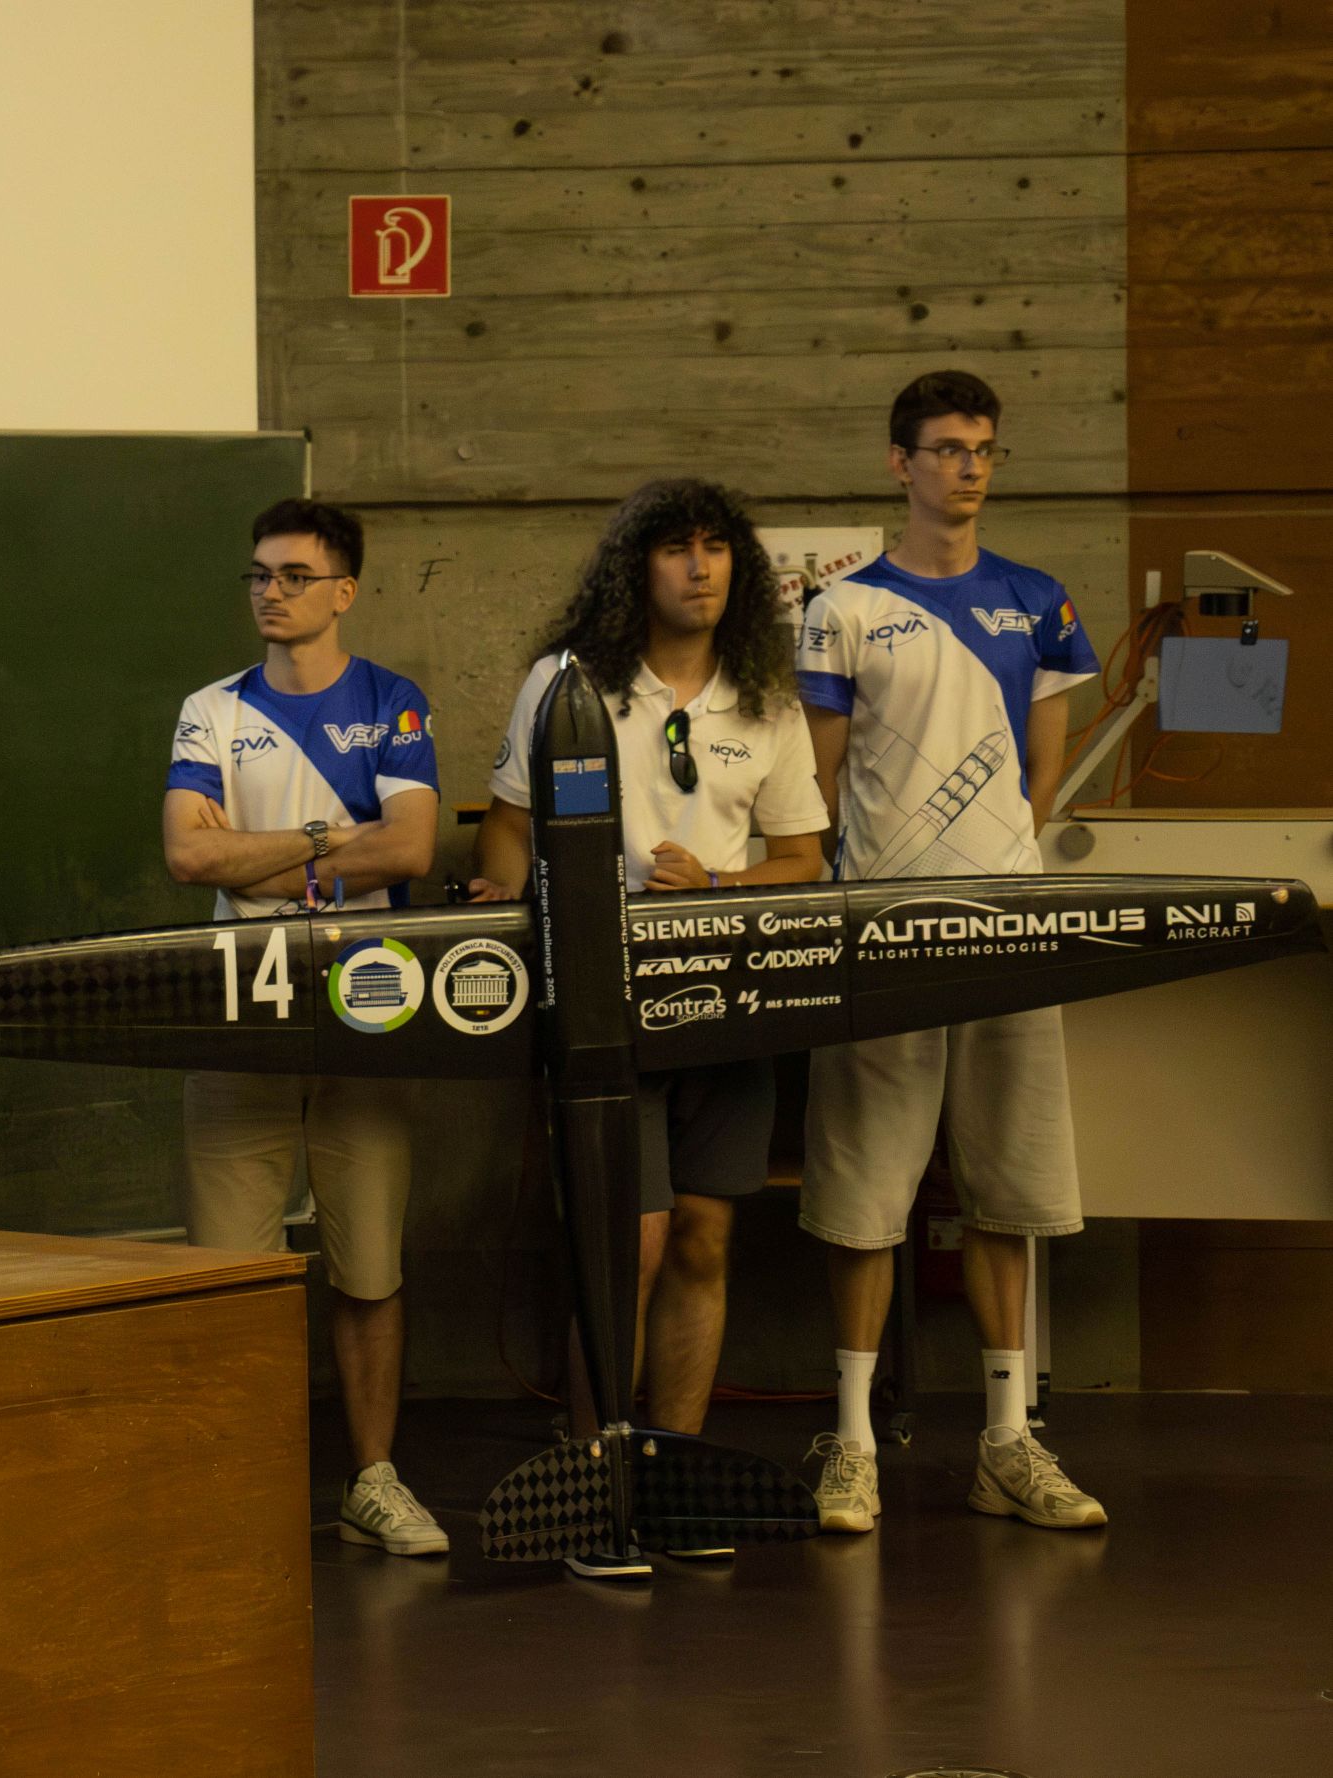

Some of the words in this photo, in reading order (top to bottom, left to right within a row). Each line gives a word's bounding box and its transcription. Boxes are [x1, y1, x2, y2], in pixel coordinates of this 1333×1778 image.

[231, 736, 278, 753] OVA
[392, 730, 422, 747] ROU
[709, 744, 752, 759] NOVA
[539, 858, 549, 876] Air
[540, 878, 550, 914] Cargo
[619, 885, 629, 944] Challenge
[781, 915, 843, 930] INCAS
[1166, 903, 1222, 926] AVI
[632, 914, 746, 942] SIEMENS
[858, 907, 1146, 945] AUTONOMOUS
[1167, 925, 1252, 940] AIRCRAFT
[543, 916, 553, 975] Challenge
[858, 948, 920, 961] FLIGHT
[924, 941, 1059, 958] TECHNOLOGIES
[622, 946, 632, 982] Cargo
[635, 955, 733, 976] KAVAN
[747, 946, 844, 970] CADDXFPV
[213, 926, 294, 1022] 14
[546, 977, 556, 1006] 2026
[624, 984, 633, 1001] Air
[766, 1000, 783, 1009] MS
[786, 995, 842, 1007] PROJECTS
[640, 998, 727, 1018] Contras
